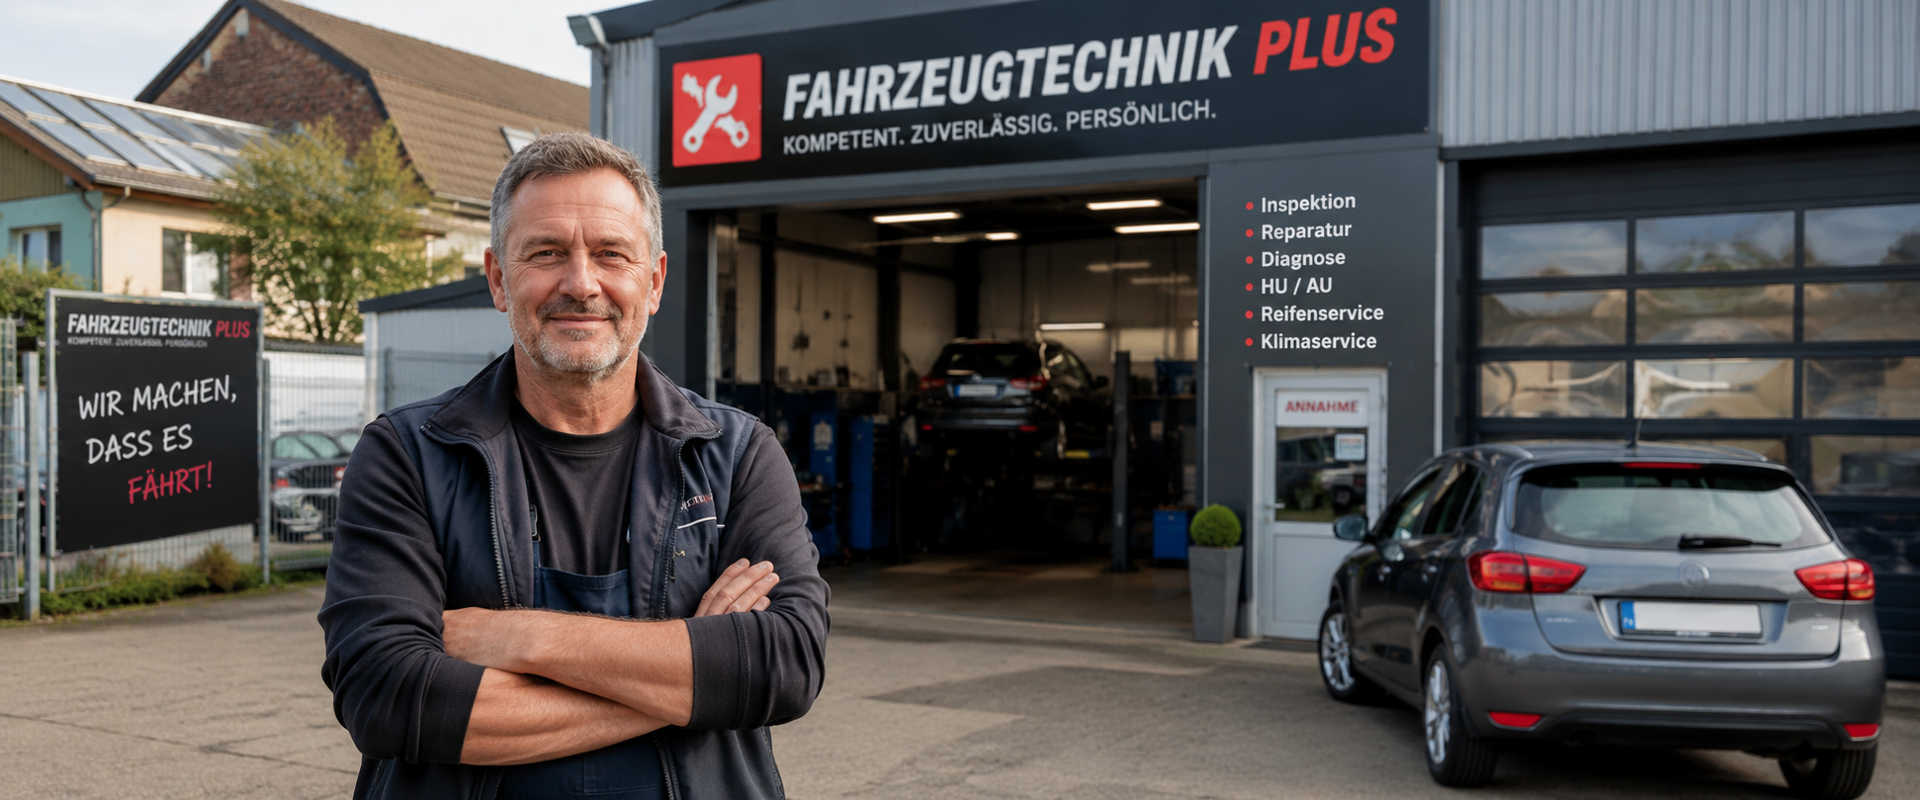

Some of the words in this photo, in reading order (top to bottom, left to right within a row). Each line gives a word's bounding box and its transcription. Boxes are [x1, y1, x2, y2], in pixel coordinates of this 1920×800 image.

[783, 25, 1239, 121] FAHRZEUGTECHNIK
[1253, 7, 1398, 75] PLUS
[783, 127, 905, 155] KOMPETENT.
[911, 111, 1058, 144] ZUVERLÄSSIG.
[1066, 99, 1217, 131] PERSÖNLICH.
[1261, 193, 1356, 215] Inspektion
[1261, 223, 1352, 243] Reparatur
[1261, 251, 1346, 270] Diagnose
[1261, 278, 1288, 294] HU
[1293, 277, 1302, 295] /
[1306, 277, 1332, 293] AU
[1261, 304, 1384, 322] Reifenservice
[67, 313, 213, 337] FAHRZEUGTECHNIK
[215, 320, 251, 338] PLUS
[1261, 332, 1377, 349] Klimaservice
[78, 390, 125, 420] WIR
[132, 374, 237, 413] MACHEN,
[1284, 401, 1359, 414] ANNAHME
[85, 430, 153, 465] DASS
[162, 424, 193, 452] ES
[128, 460, 213, 504] FÄHRT!
